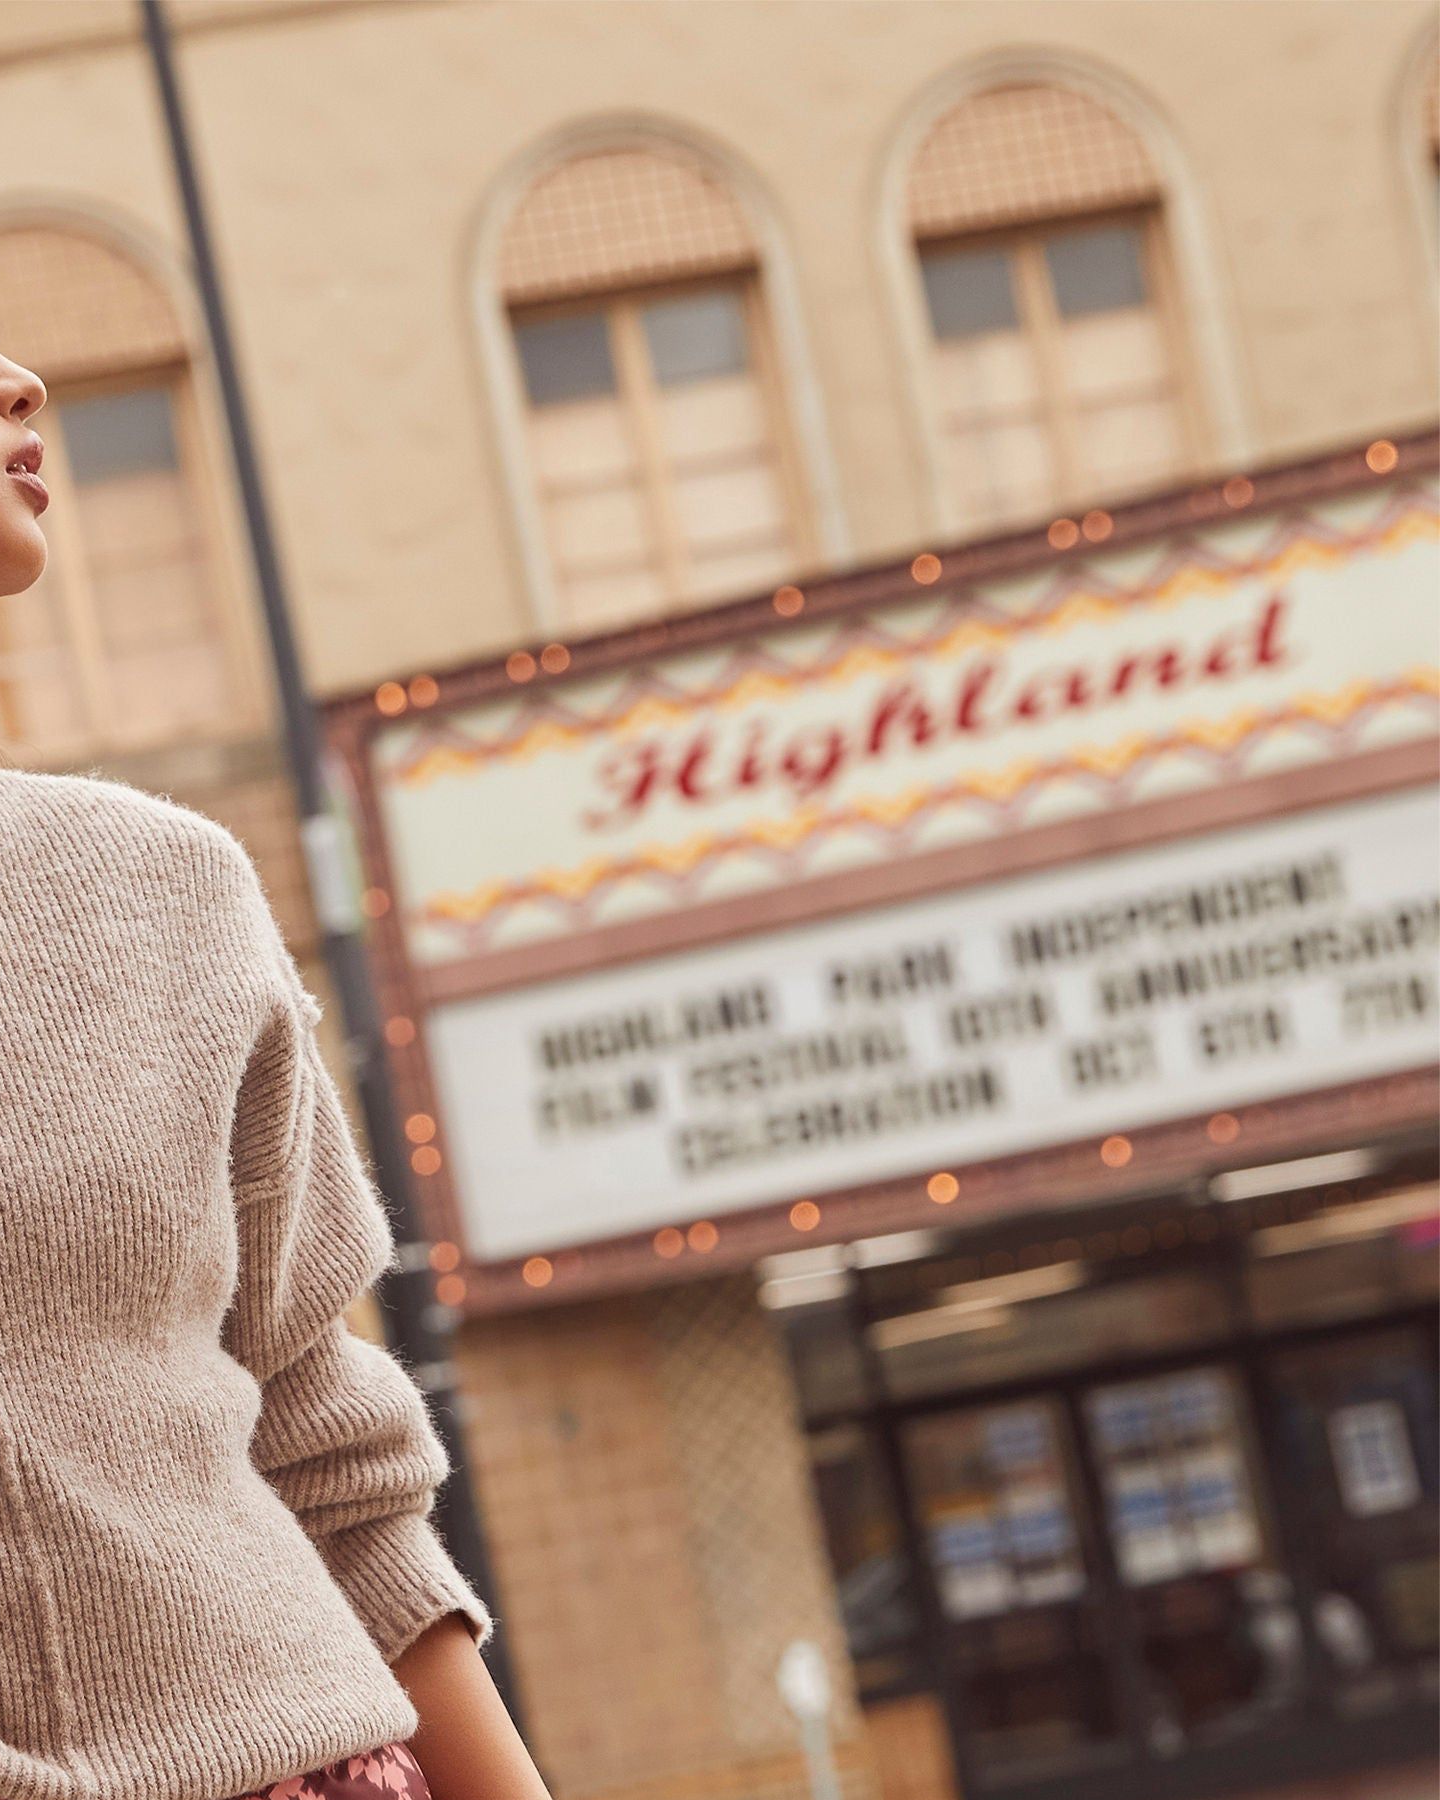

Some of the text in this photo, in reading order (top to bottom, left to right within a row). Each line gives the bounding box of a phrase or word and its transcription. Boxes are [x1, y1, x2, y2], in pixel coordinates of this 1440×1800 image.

[580, 588, 1300, 832] Highland
[537, 858, 1345, 1074] HIGHLAND PARK INDEPENDENT
[539, 1068, 656, 1136] FILM
[688, 1015, 908, 1105] FESTIVAL
[675, 969, 1430, 1174] CELEBRATION OCT 6TH 7TH
